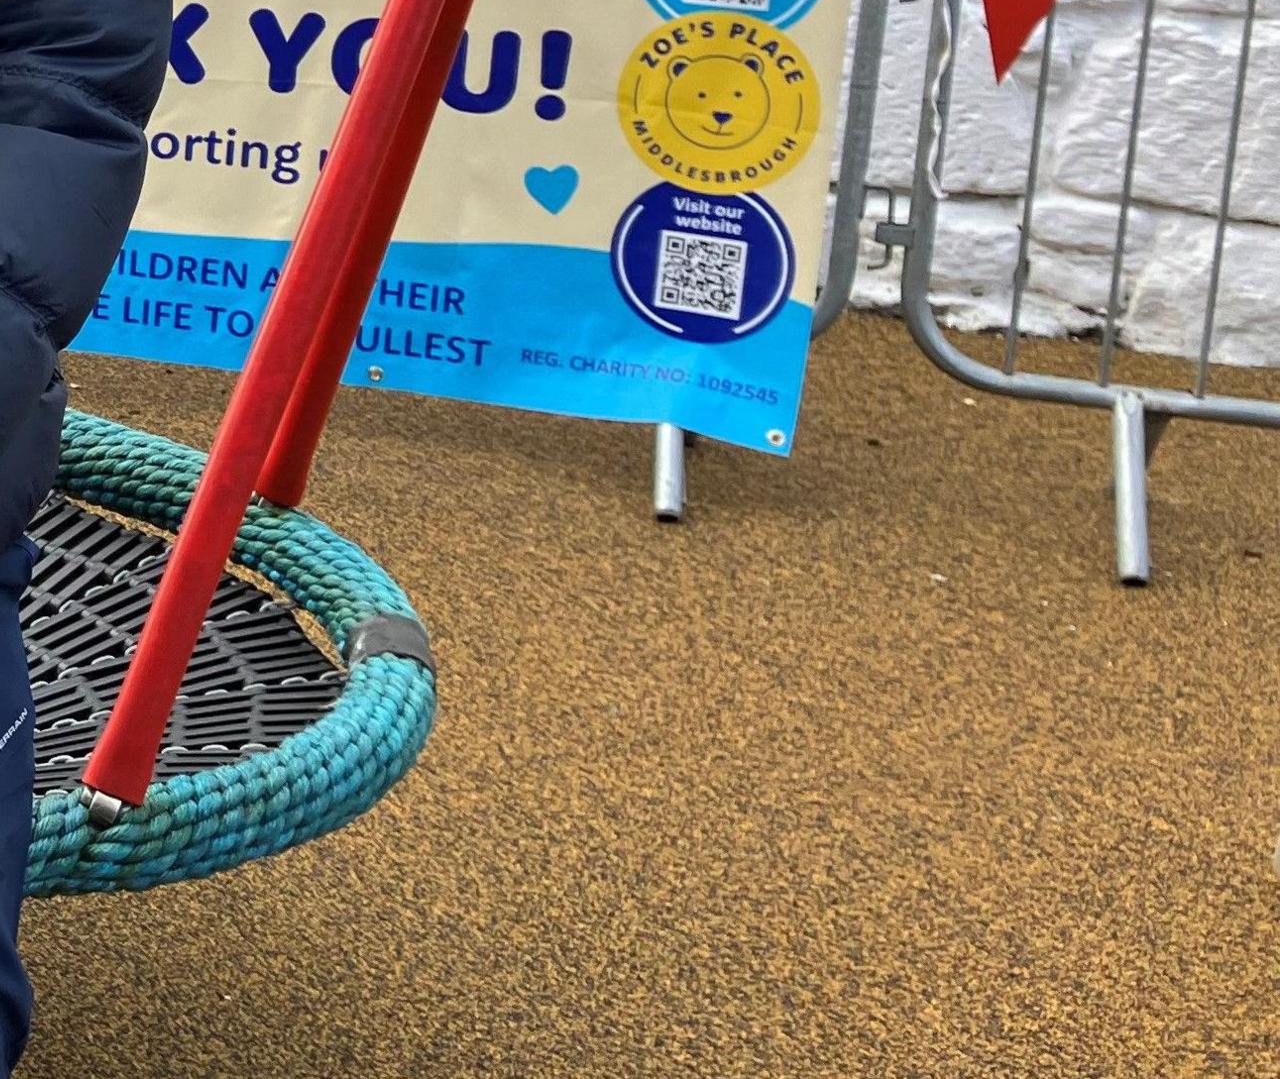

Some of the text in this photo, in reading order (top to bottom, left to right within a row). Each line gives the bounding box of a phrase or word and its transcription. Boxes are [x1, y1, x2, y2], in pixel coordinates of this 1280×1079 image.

[640, 21, 804, 85] ZOE'S PLACE
[150, 128, 302, 184] orting
[632, 120, 798, 184] MIDDLESBROUGH
[673, 196, 745, 219] Visit our
[674, 214, 743, 235] website
[118, 248, 248, 289] ILDREN
[378, 278, 465, 315] HEIR
[123, 295, 192, 330] LIFE
[205, 304, 254, 338] TO
[355, 324, 493, 366] ULLEST
[521, 347, 563, 368] REG.
[569, 354, 651, 380] CHARITY
